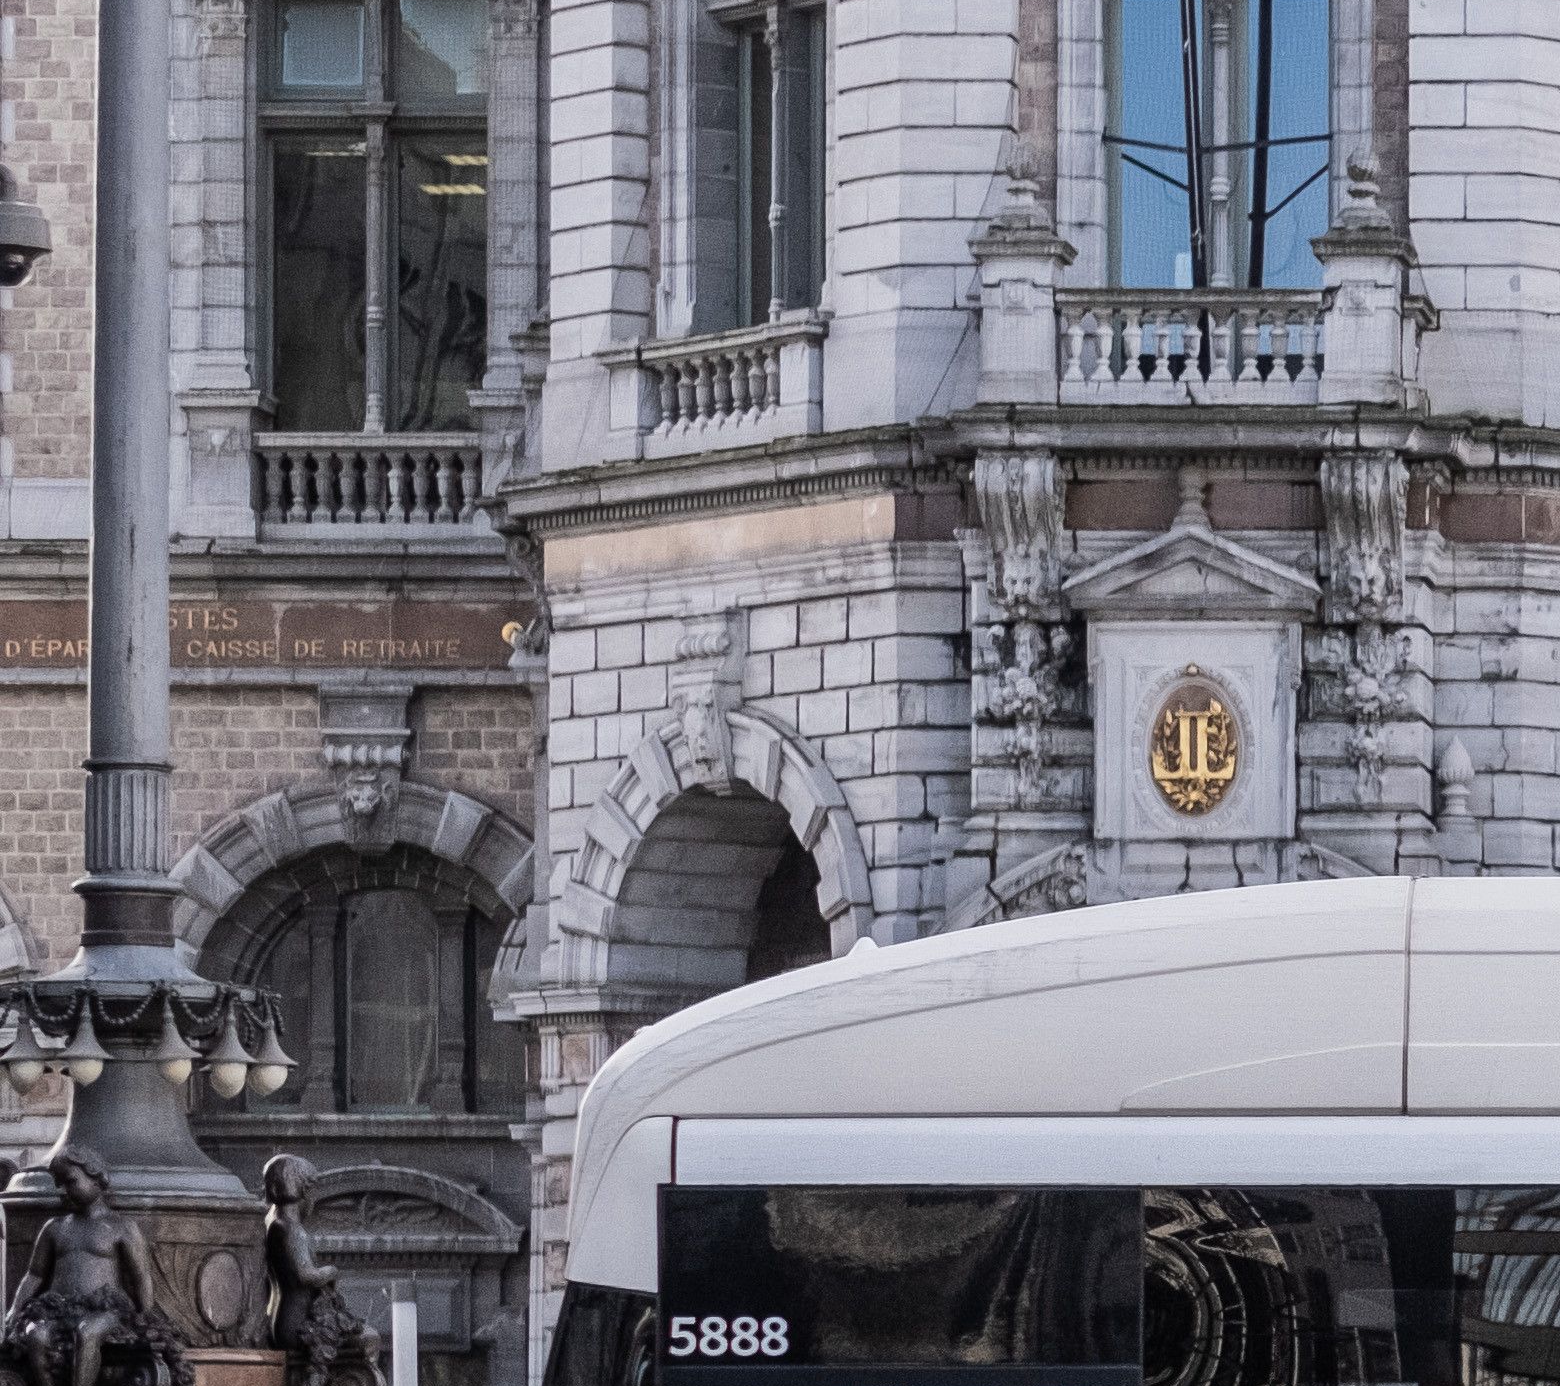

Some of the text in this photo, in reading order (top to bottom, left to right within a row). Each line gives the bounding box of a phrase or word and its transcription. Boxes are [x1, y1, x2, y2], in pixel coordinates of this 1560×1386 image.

[186, 639, 277, 658] CAISSE
[294, 639, 326, 658] DE
[342, 638, 461, 659] RETRAITE
[669, 1316, 789, 1357] 5888
